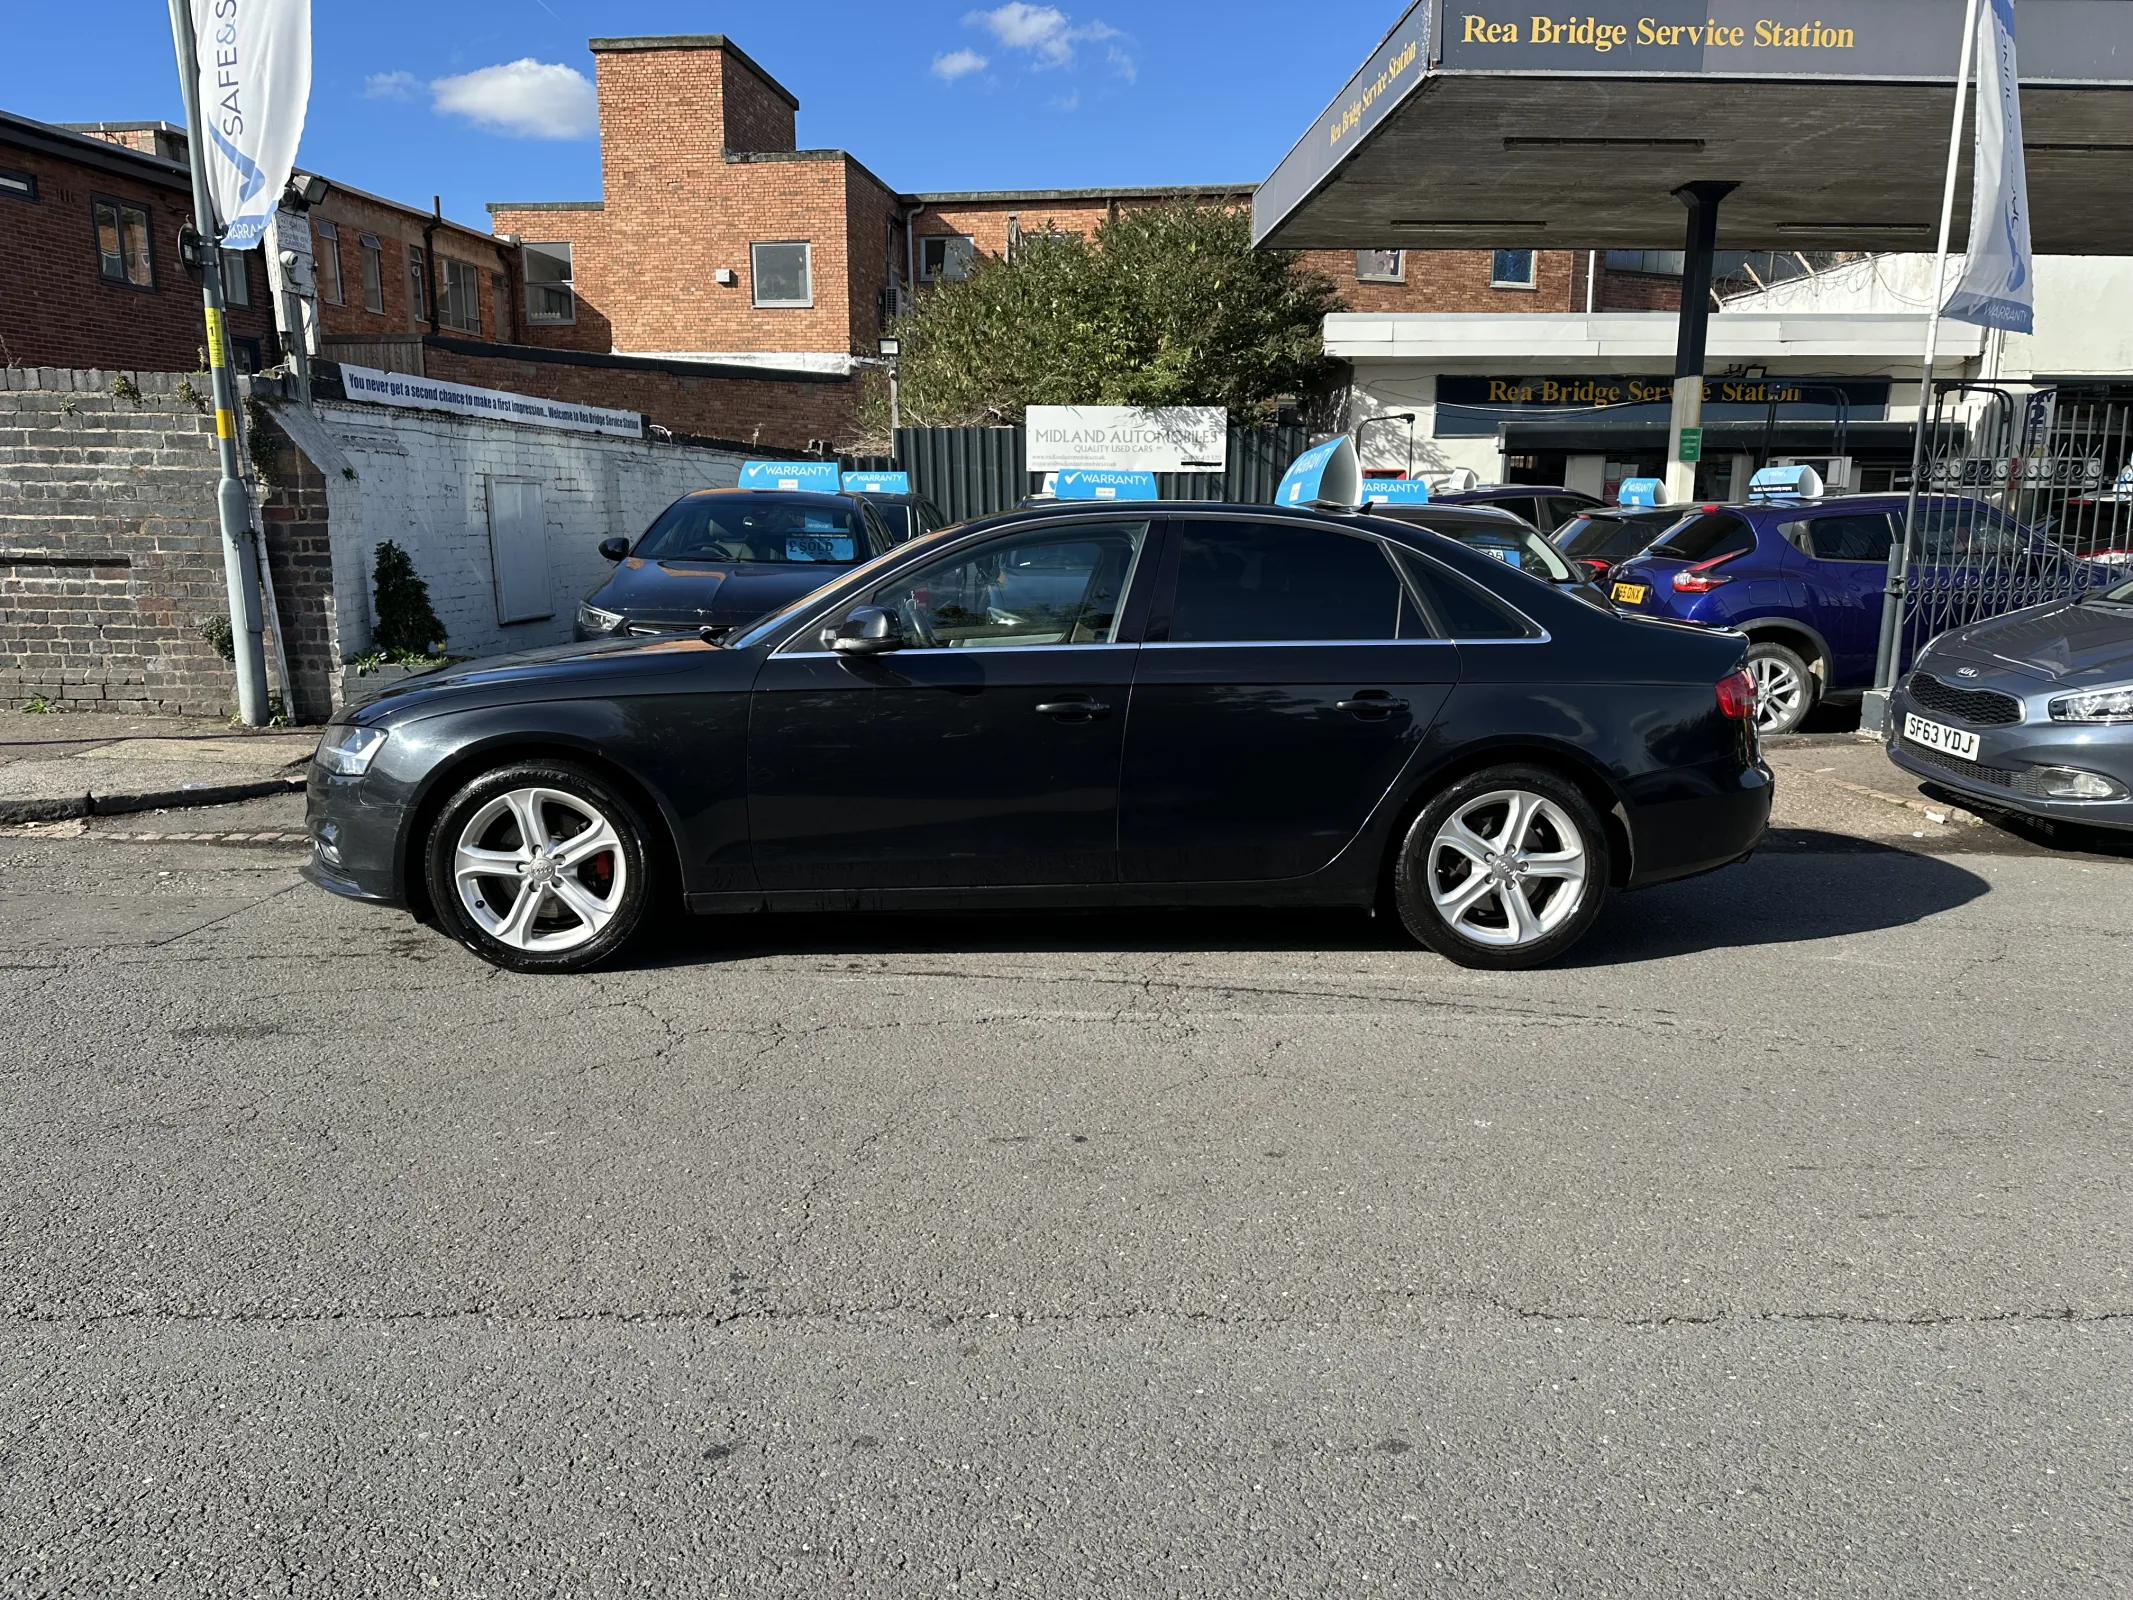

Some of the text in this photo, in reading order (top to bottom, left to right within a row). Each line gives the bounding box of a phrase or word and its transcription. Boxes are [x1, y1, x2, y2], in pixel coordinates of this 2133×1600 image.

[1461, 15, 1855, 52] Rea Bridge Service Station
[1330, 40, 1416, 148] Rea Bridge Service Station
[1984, 303, 2028, 323] WARRANTY
[209, 325, 214, 337] 1
[1488, 381, 1533, 401] Rea
[1541, 380, 1620, 407] Bridge
[1628, 380, 1711, 401] Sere
[349, 373, 365, 389] You
[366, 378, 389, 394] never
[390, 382, 404, 396] get
[405, 385, 410, 395] a
[411, 386, 438, 401] second
[439, 388, 465, 405] chance
[465, 393, 473, 406] to
[474, 395, 492, 410] make
[493, 399, 497, 410] a
[498, 398, 511, 412] first
[548, 406, 573, 420] Welcome
[573, 411, 580, 422] to
[580, 411, 589, 423] Rea
[589, 412, 606, 427] Bridge
[606, 415, 623, 428] Service
[623, 417, 639, 430] Station
[1035, 430, 1218, 443] MIDLAND AUTOMOBILES
[1074, 445, 1153, 453] QUALITY USED CARS
[765, 465, 832, 477] WARRANTY
[857, 474, 903, 482] WARRANTY
[1081, 474, 1149, 486] WARRANTY
[800, 541, 834, 552] SOLD
[1958, 667, 1975, 676] KIA
[1909, 717, 1975, 753] SF63 YDJ
